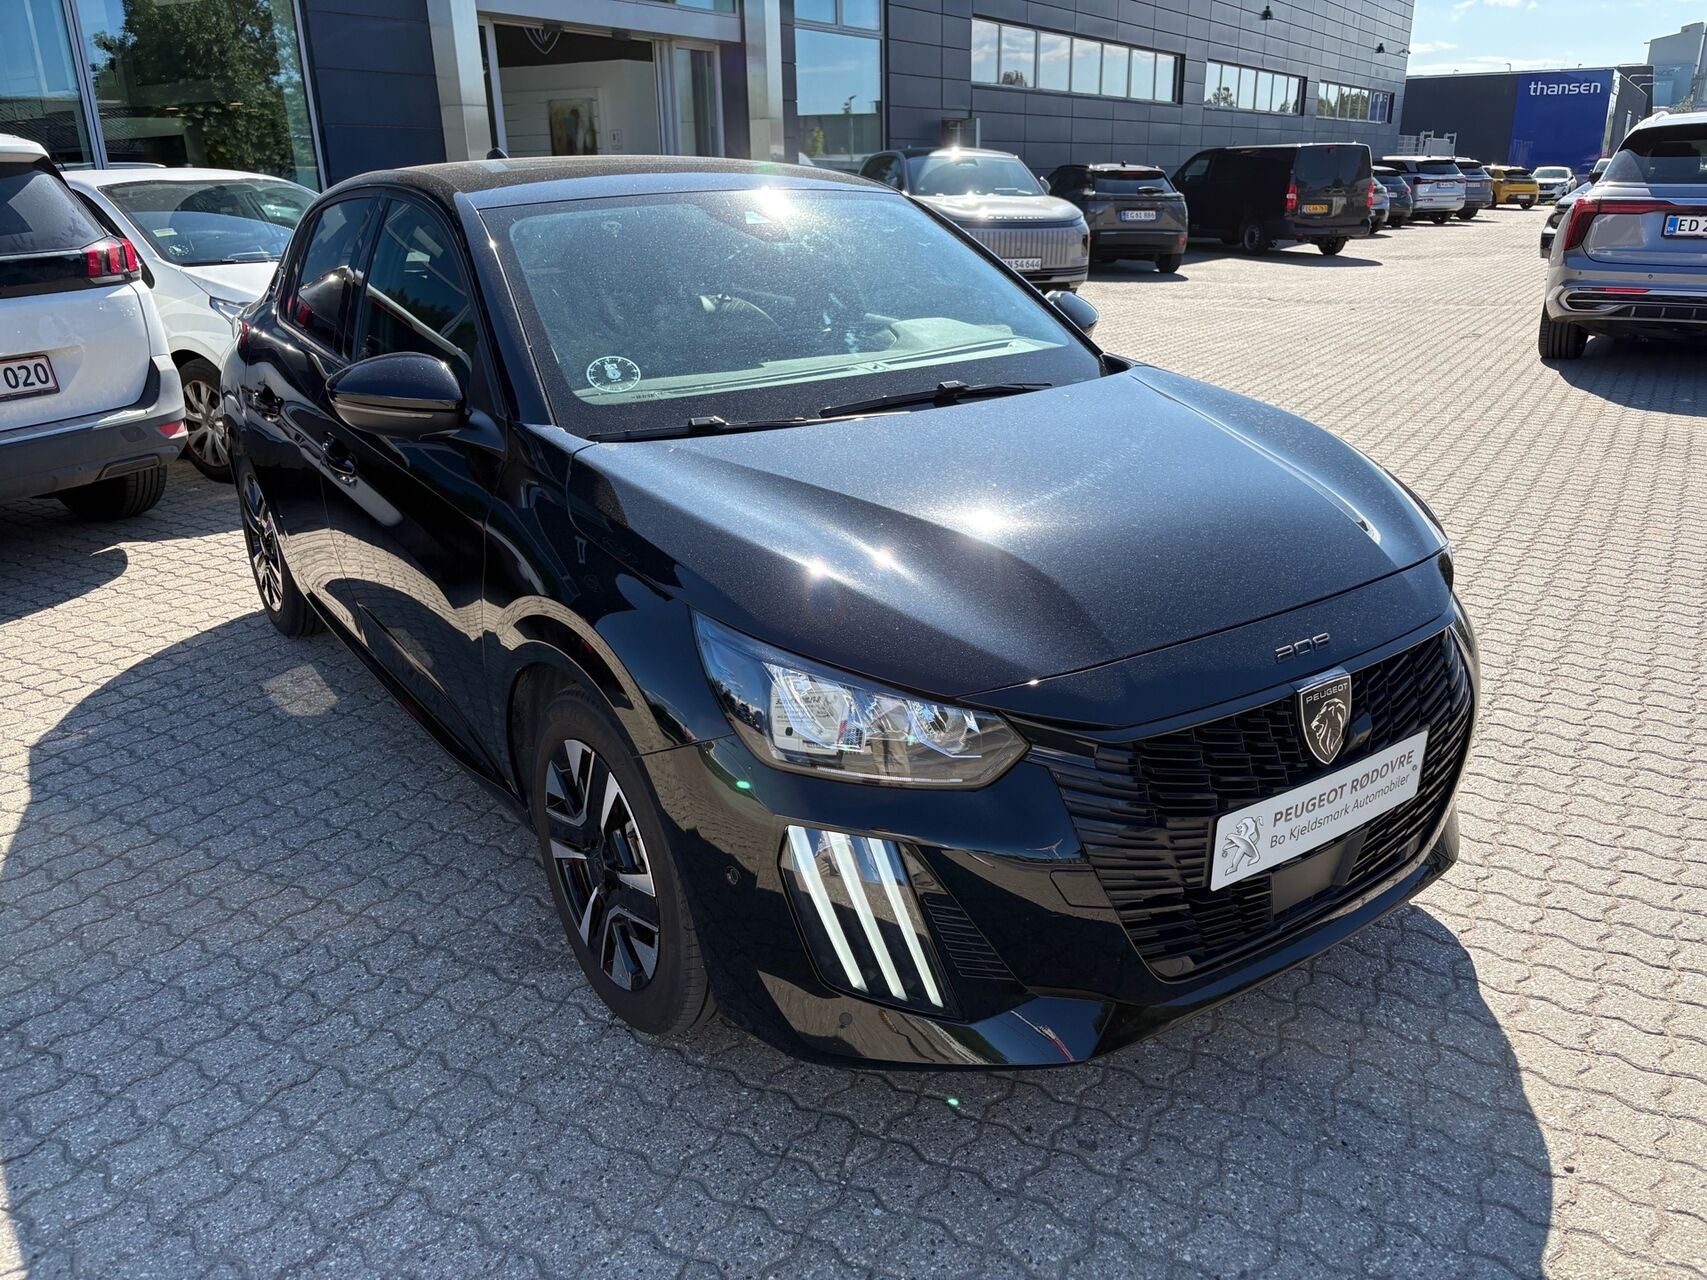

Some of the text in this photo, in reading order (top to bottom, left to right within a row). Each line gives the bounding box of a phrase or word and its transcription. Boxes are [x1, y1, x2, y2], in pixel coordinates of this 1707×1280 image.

[1529, 81, 1601, 96] thansen
[1678, 219, 1700, 232] ED
[1014, 260, 1025, 269] 54
[1025, 260, 1040, 269] 644
[3, 362, 50, 389] 020
[1305, 682, 1348, 704] PEUGEOT
[1273, 749, 1415, 827] PEUGEOT RØDOVRE
[1270, 774, 1410, 848] Bo Kjeldsmark Automobiler
